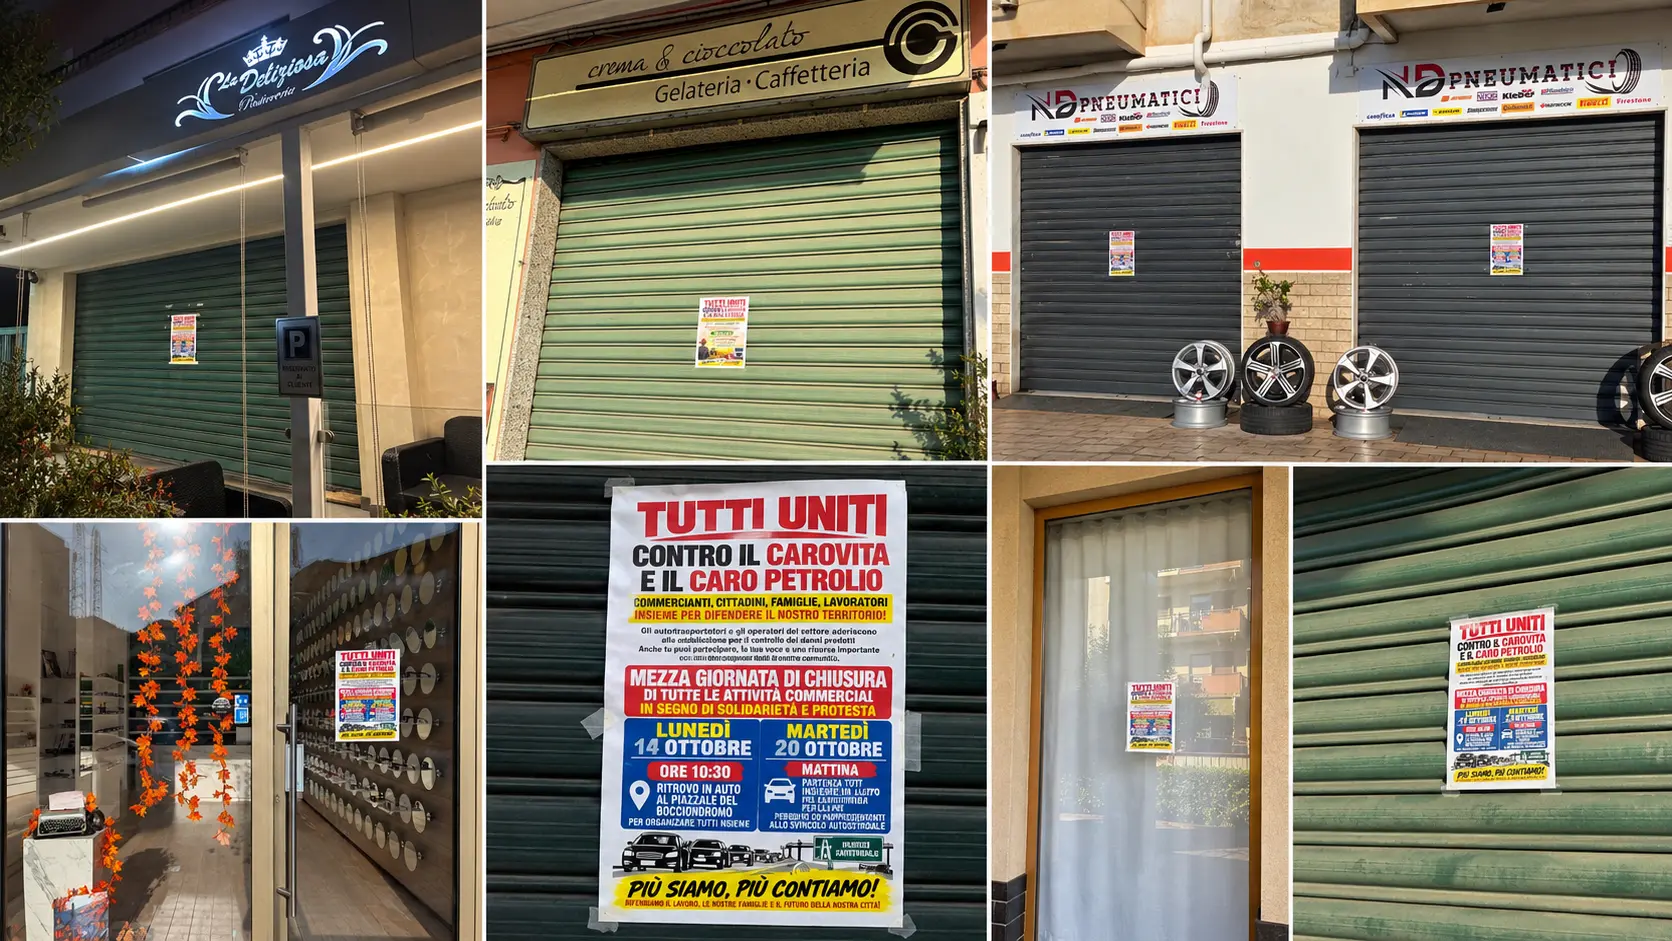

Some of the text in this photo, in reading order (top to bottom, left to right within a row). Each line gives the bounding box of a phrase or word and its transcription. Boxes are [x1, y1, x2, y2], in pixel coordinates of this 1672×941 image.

[588, 20, 810, 79] crema & cioccolato
[239, 50, 329, 95] Deliziosa
[655, 57, 870, 103] Gelateria Caffetteria
[1449, 60, 1616, 90] PNEUMATICI
[1080, 88, 1201, 113] PNEUMATICI
[289, 330, 306, 358] P
[637, 494, 887, 537] TUTTI UNITI
[632, 543, 890, 568] CONTRO IL CAROVITA
[641, 568, 883, 592] E IL CARO PETROLIO
[633, 597, 888, 608] COMMERCIANTI, CITTADINI, FAMIGLIE, LAVORATORI
[634, 610, 678, 620] INSIEME
[681, 610, 701, 620] PER
[705, 610, 763, 620] DIFENDERE
[766, 610, 775, 620] IL
[778, 610, 819, 620] NOSTRO
[1459, 614, 1545, 640] TUTTI UNITI
[1457, 639, 1491, 652] CONTRO
[1501, 633, 1546, 647] CAROVITA
[1459, 651, 1466, 661] E
[1501, 644, 1544, 657] PETROLIO
[630, 669, 887, 689] MEZZA GIORNATA DI CHIUSURA
[644, 688, 656, 701] DI
[659, 688, 702, 701] TUTTE
[704, 688, 720, 701] LE
[723, 686, 782, 702] ATTIVITÀ
[640, 701, 877, 717] IN SEGNO DI SOLIDARIETÀ E PROTESTA
[656, 720, 731, 738] LUNEDÌ
[787, 721, 869, 740] MARTEDÌ
[634, 738, 752, 756] 14 OTTOBRE
[775, 740, 883, 757] 20 OTTOBRE
[659, 764, 731, 779] ORE 10:30
[801, 763, 859, 777] MATTINA
[656, 783, 741, 795] RITROVO IN AUTO
[656, 795, 738, 806] AL PIAZZALE DEL
[628, 818, 643, 826] PER
[697, 819, 718, 828] TUTTI
[769, 821, 788, 829] ALLO
[627, 875, 880, 899] PIÙ SIAMO, PIÙ CONTIAMO!
